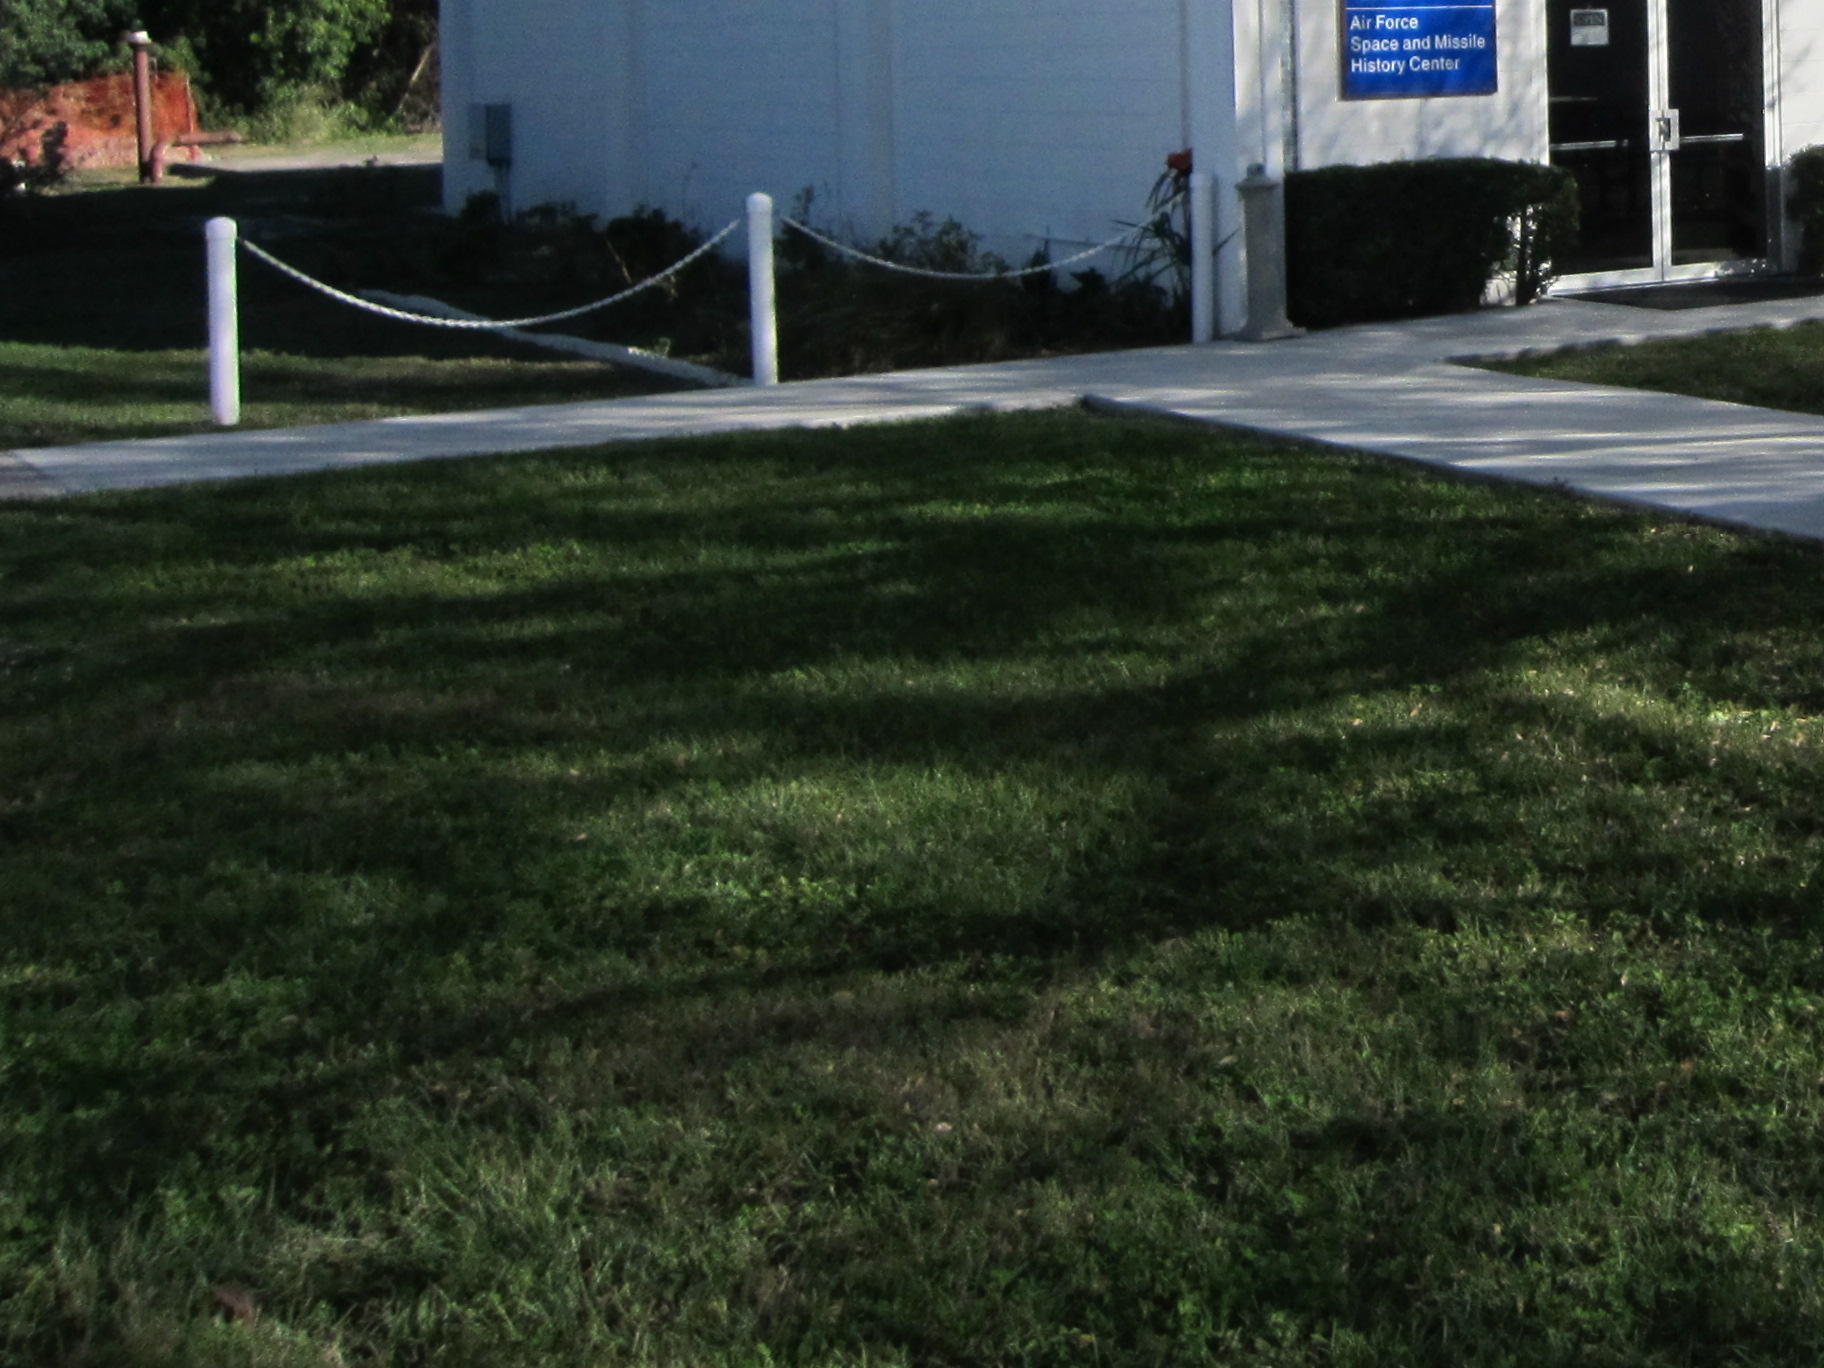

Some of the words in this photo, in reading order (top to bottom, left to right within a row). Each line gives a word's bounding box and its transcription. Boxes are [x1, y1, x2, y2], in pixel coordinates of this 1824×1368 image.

[1350, 15, 1372, 30] Air
[1376, 14, 1419, 30] Force
[1350, 36, 1399, 54] Space
[1402, 36, 1431, 50] and
[1434, 34, 1486, 49] Missile
[1351, 58, 1406, 75] History
[1409, 56, 1460, 71] Center
